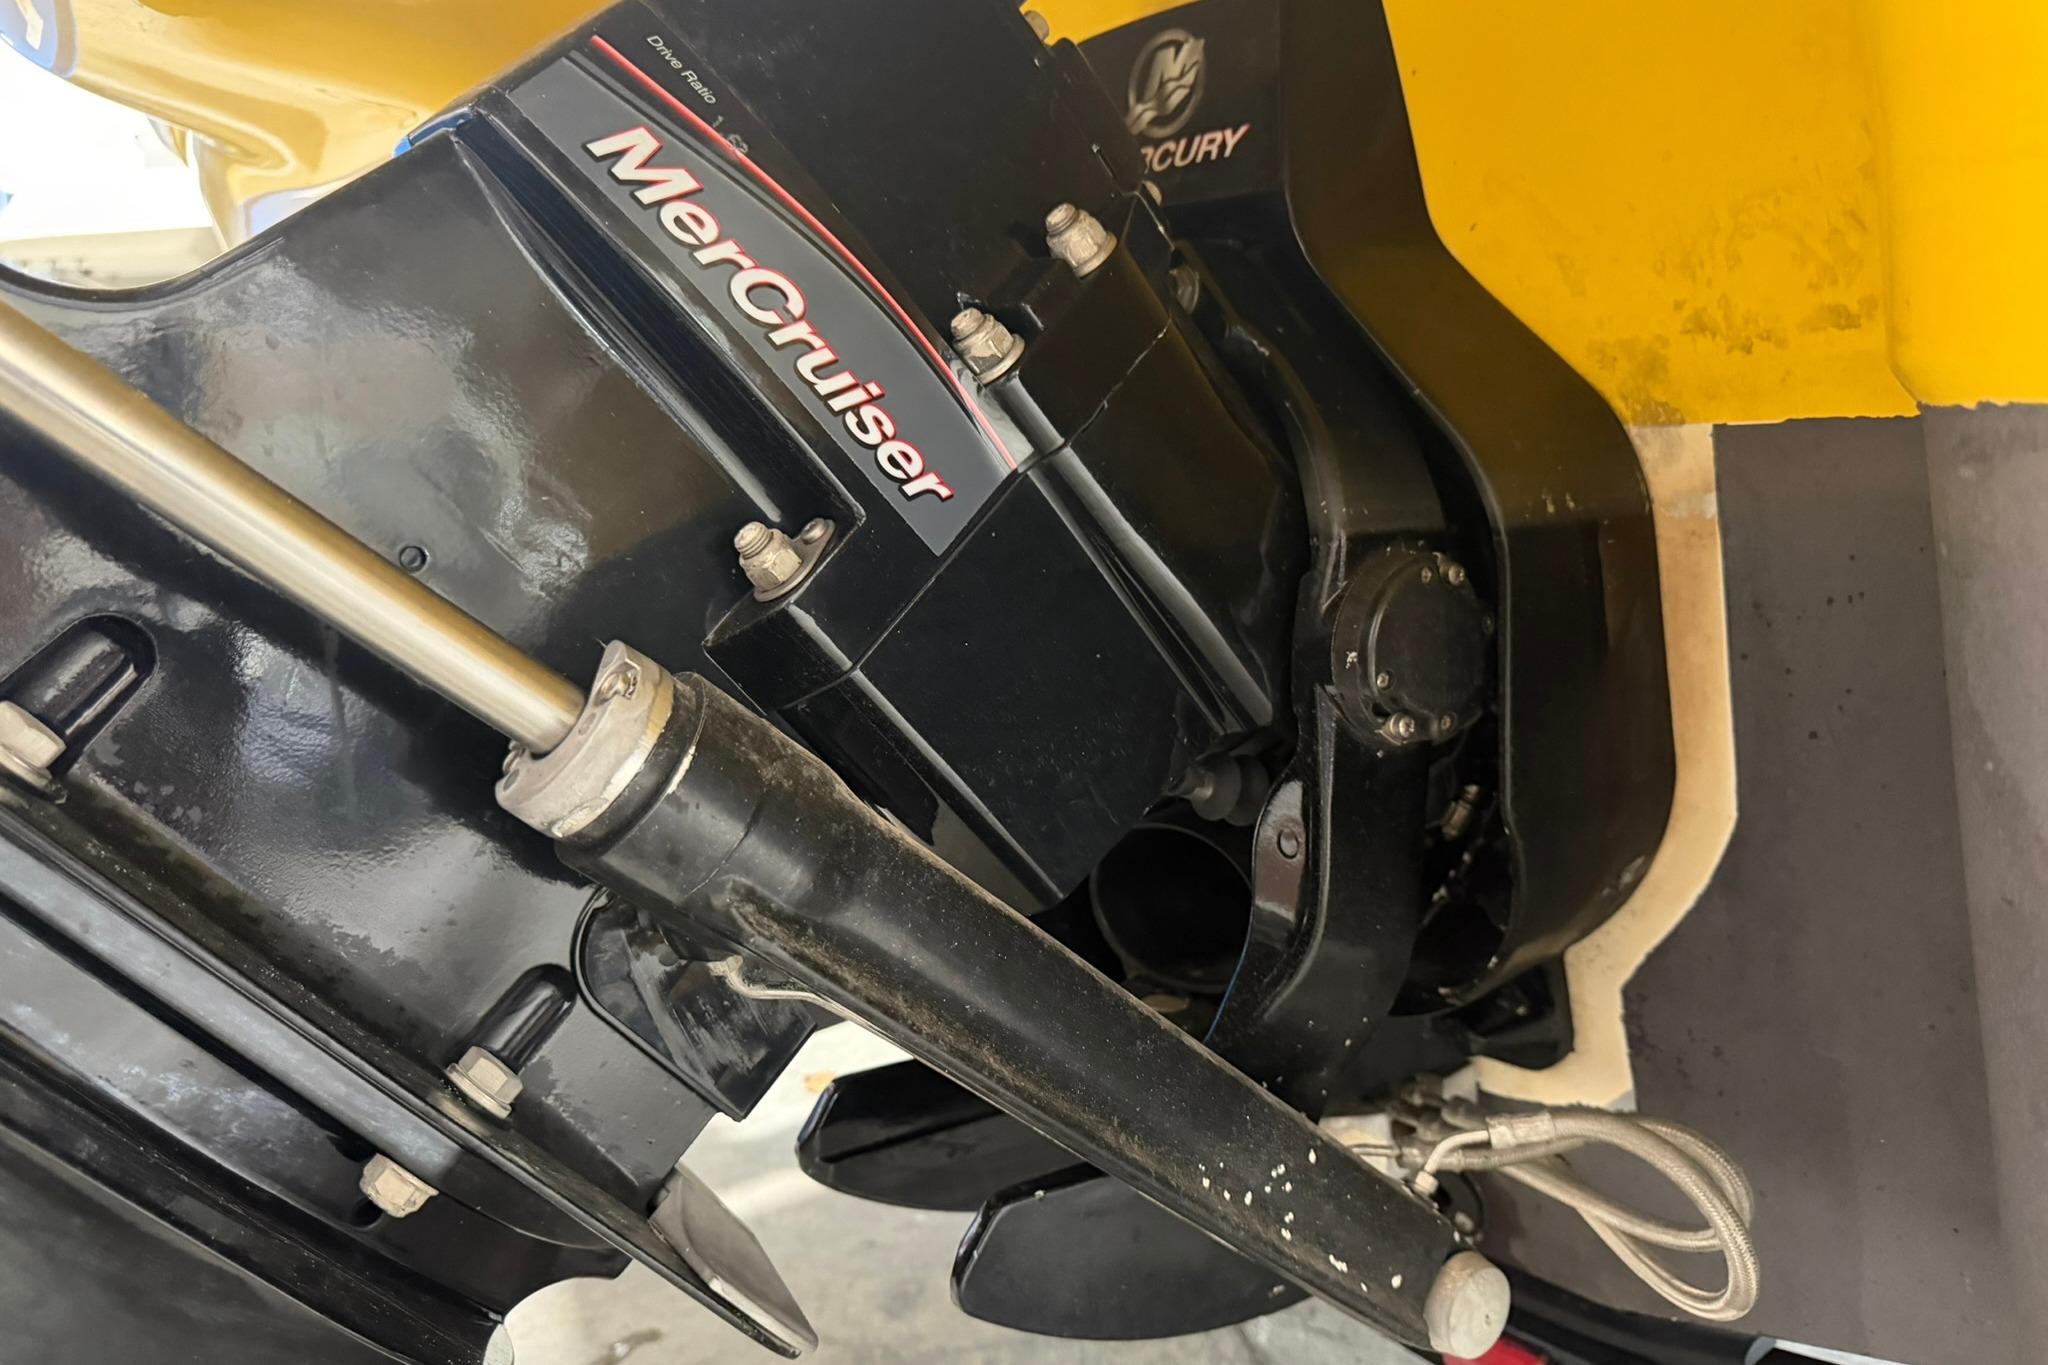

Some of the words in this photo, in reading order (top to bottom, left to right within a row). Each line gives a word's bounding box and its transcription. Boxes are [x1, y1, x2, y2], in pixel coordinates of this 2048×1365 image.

[646, 35, 683, 69] Drive
[681, 70, 716, 104] Ratio
[585, 127, 954, 503] MerCruiser
